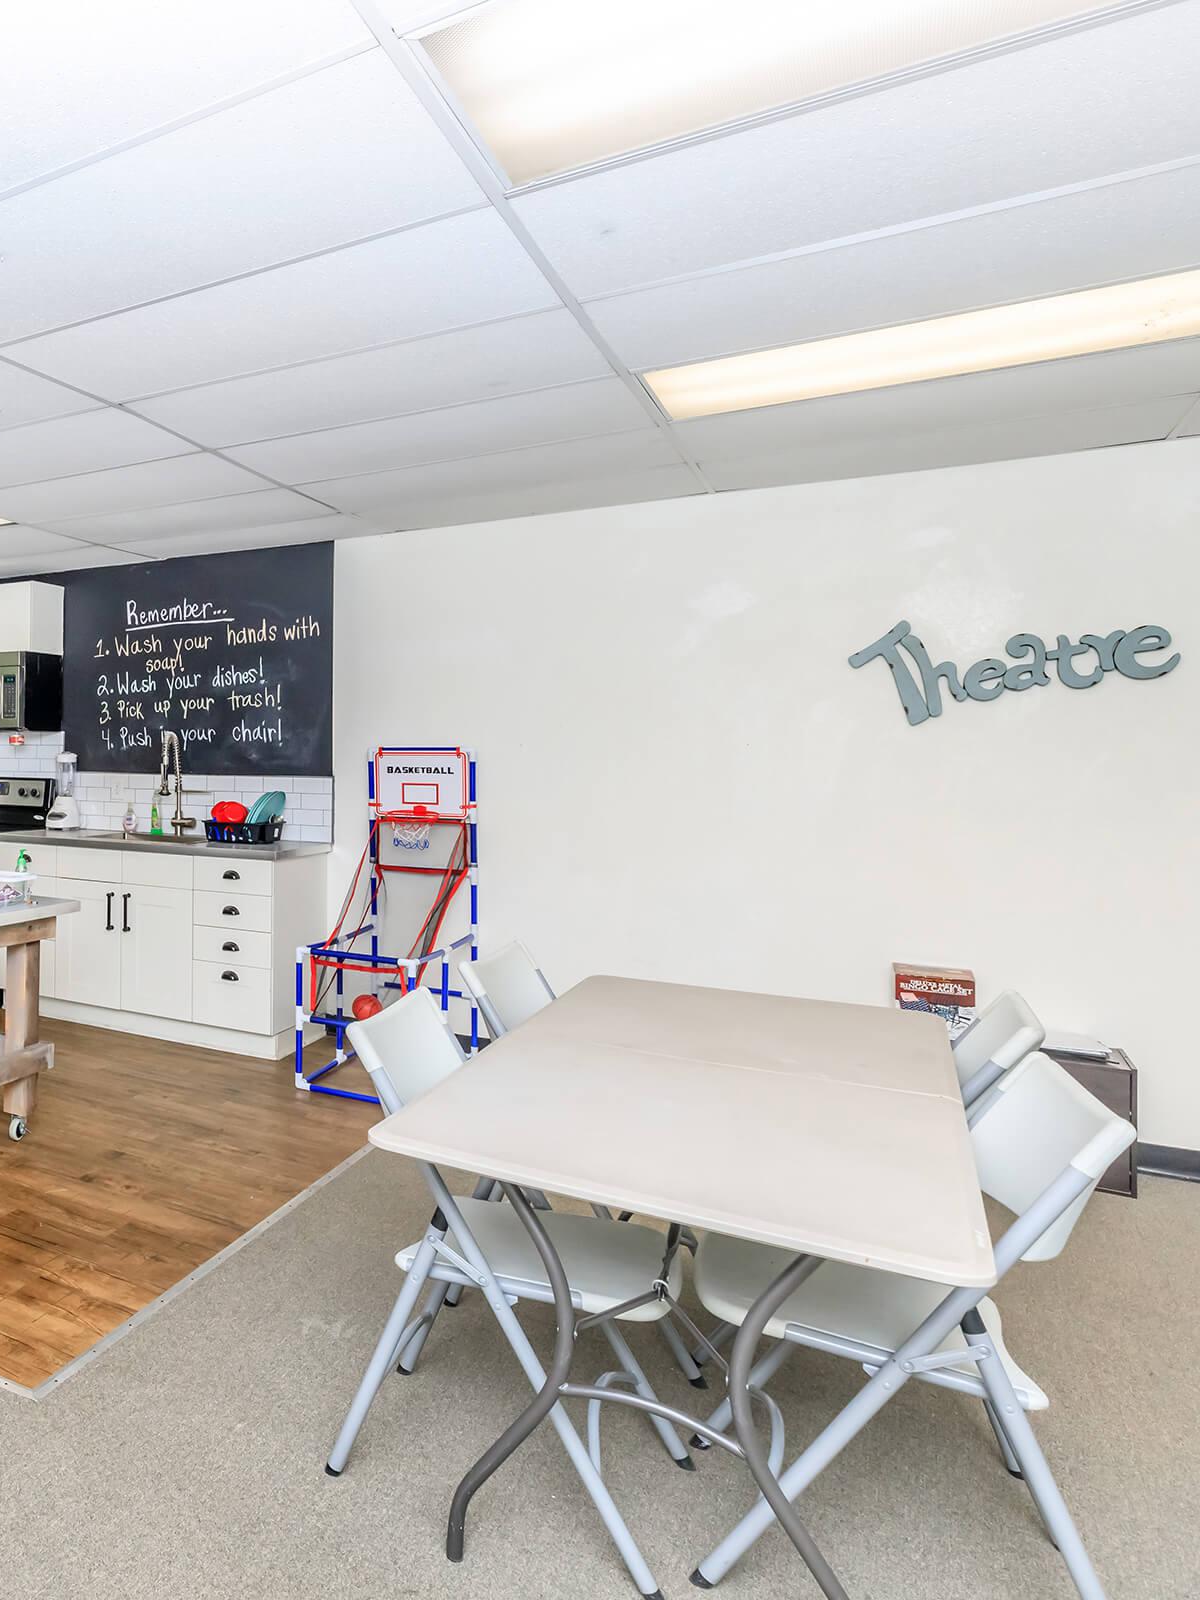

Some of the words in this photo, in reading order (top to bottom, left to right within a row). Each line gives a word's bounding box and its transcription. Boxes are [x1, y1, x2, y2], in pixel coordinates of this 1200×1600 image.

[94, 639, 110, 658] 1.
[114, 633, 162, 657] Wash
[173, 635, 213, 668] your
[227, 618, 277, 646] hands
[284, 615, 320, 640] with
[97, 674, 114, 696] 2.
[116, 671, 156, 695] Wash
[166, 673, 201, 698] your
[212, 656, 264, 687] dishes!
[145, 654, 185, 677] soap!
[848, 620, 1181, 726] Theatre
[99, 701, 112, 724] 3.
[117, 700, 145, 720] Pick
[154, 700, 171, 718] up
[180, 696, 215, 720] your
[228, 684, 282, 711] trash!
[101, 728, 114, 750] 4.
[120, 727, 152, 751] Push
[180, 728, 216, 752] your
[232, 718, 282, 747] chair!
[386, 766, 454, 775] BASKETBALL
[899, 982, 928, 992] BINGO
